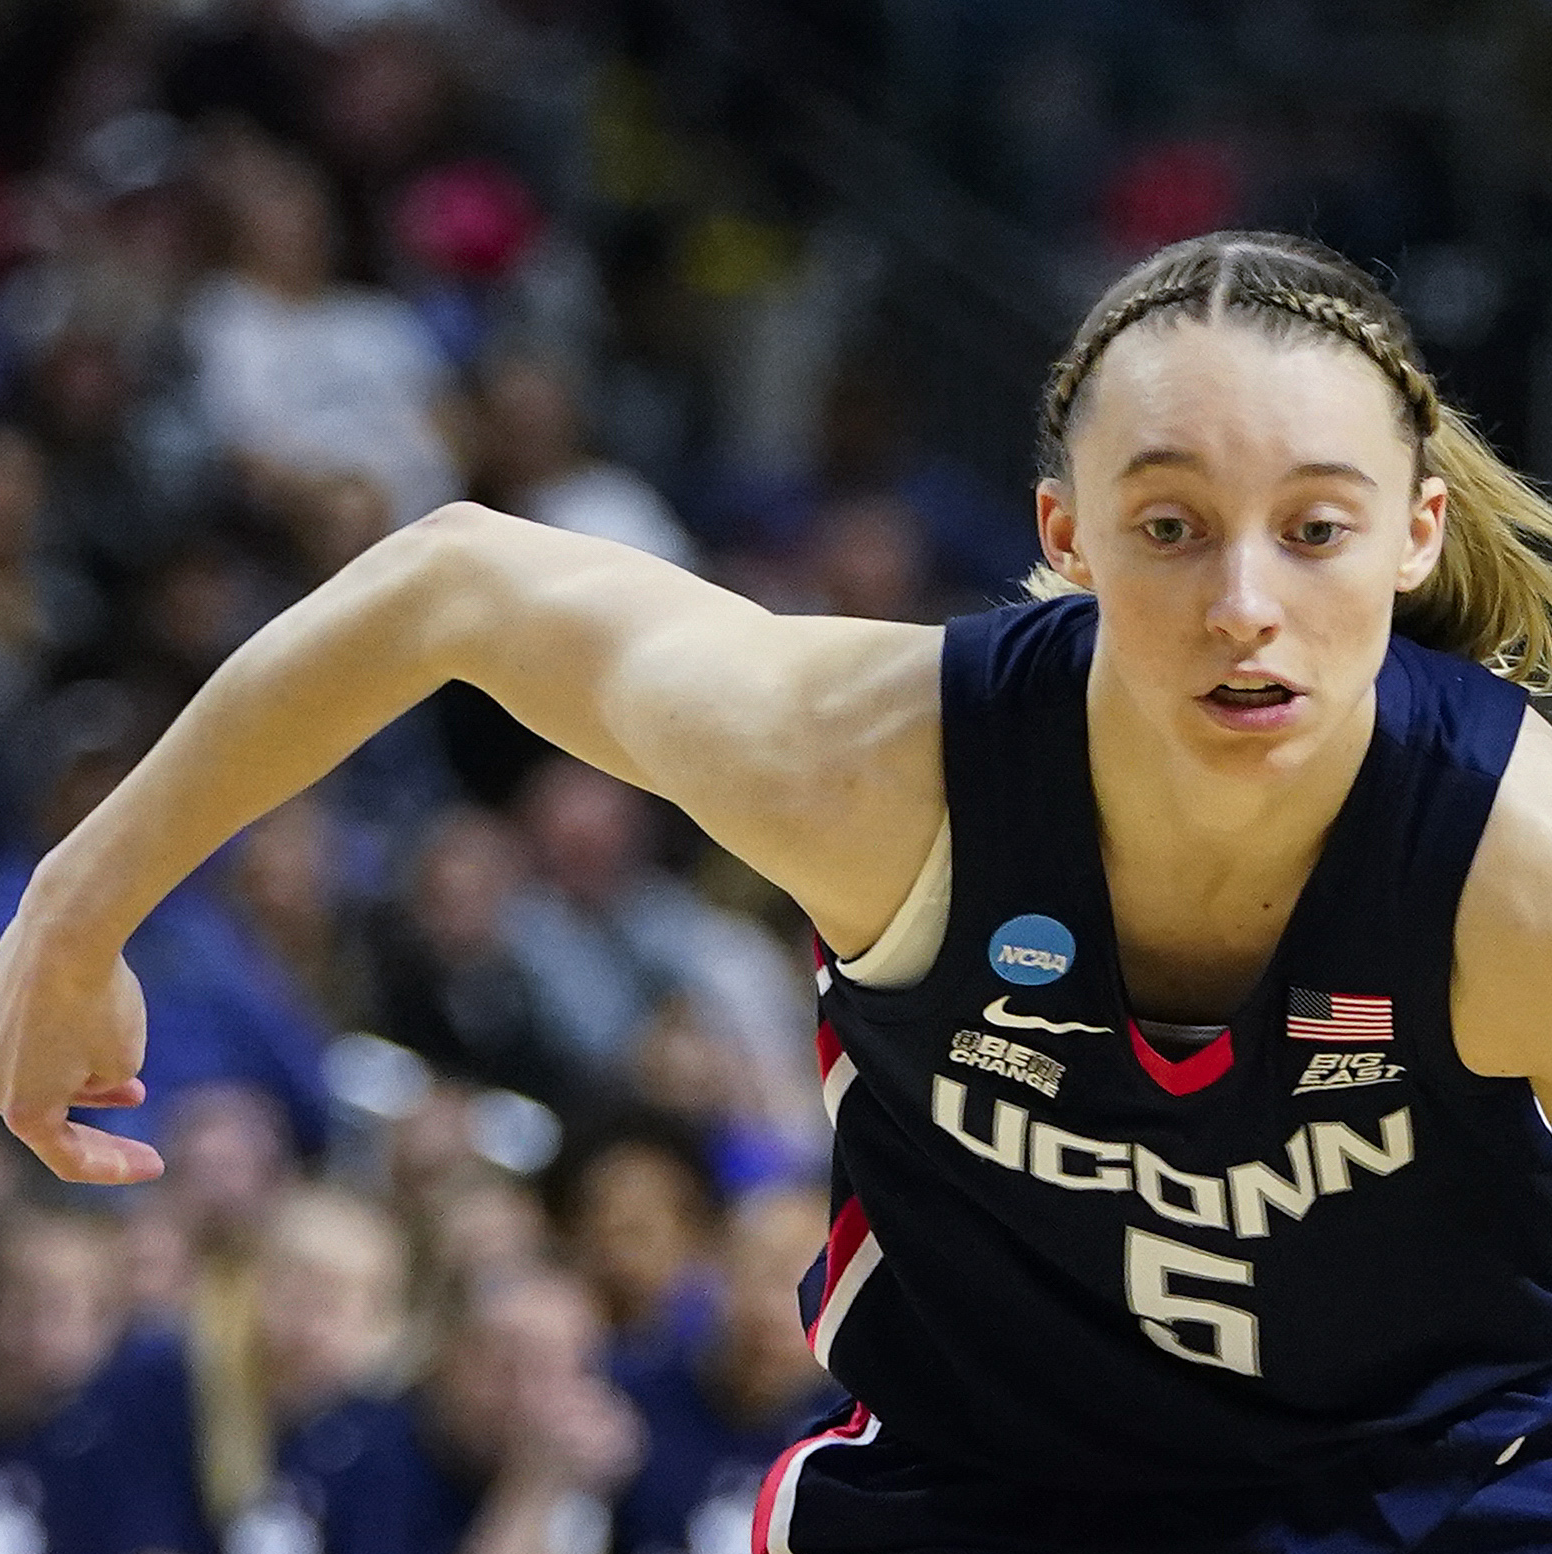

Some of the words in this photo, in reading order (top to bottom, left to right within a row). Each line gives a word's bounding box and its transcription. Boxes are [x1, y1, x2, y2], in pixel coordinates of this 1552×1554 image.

[997, 944, 1068, 974] NCAA
[949, 1048, 1061, 1099] CHANGE
[1298, 1063, 1408, 1086] EAST
[1307, 1052, 1387, 1070] BIG
[932, 1073, 1417, 1240] UCONN
[1123, 1224, 1264, 1378] 5
